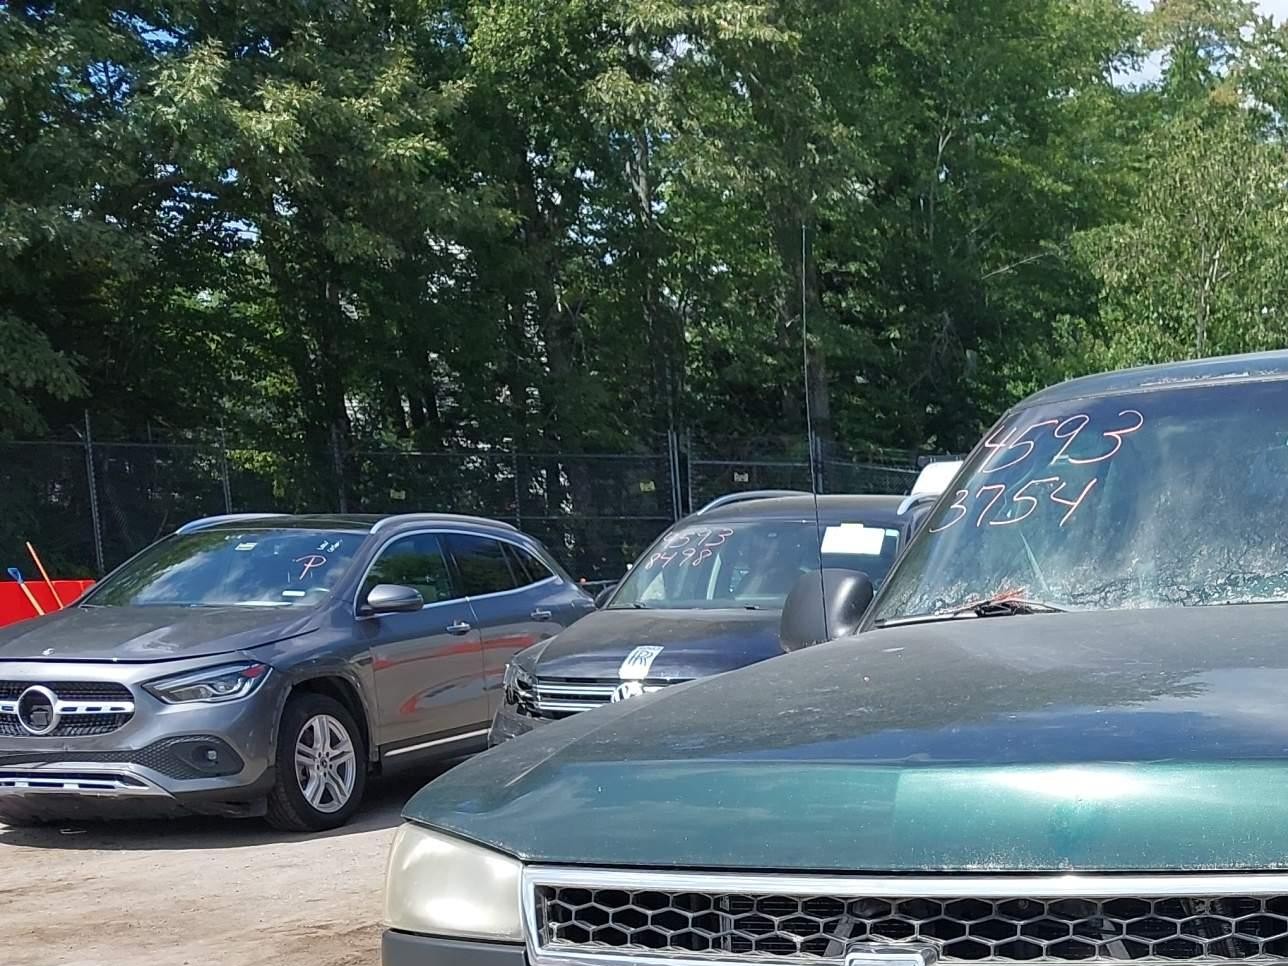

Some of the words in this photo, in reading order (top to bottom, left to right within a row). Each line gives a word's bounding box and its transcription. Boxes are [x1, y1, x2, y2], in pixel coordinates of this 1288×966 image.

[977, 409, 1145, 474] 4593
[928, 477, 1099, 533] 3754
[663, 527, 734, 549] 4593
[294, 554, 327, 581] P
[644, 547, 713, 570] 8498
